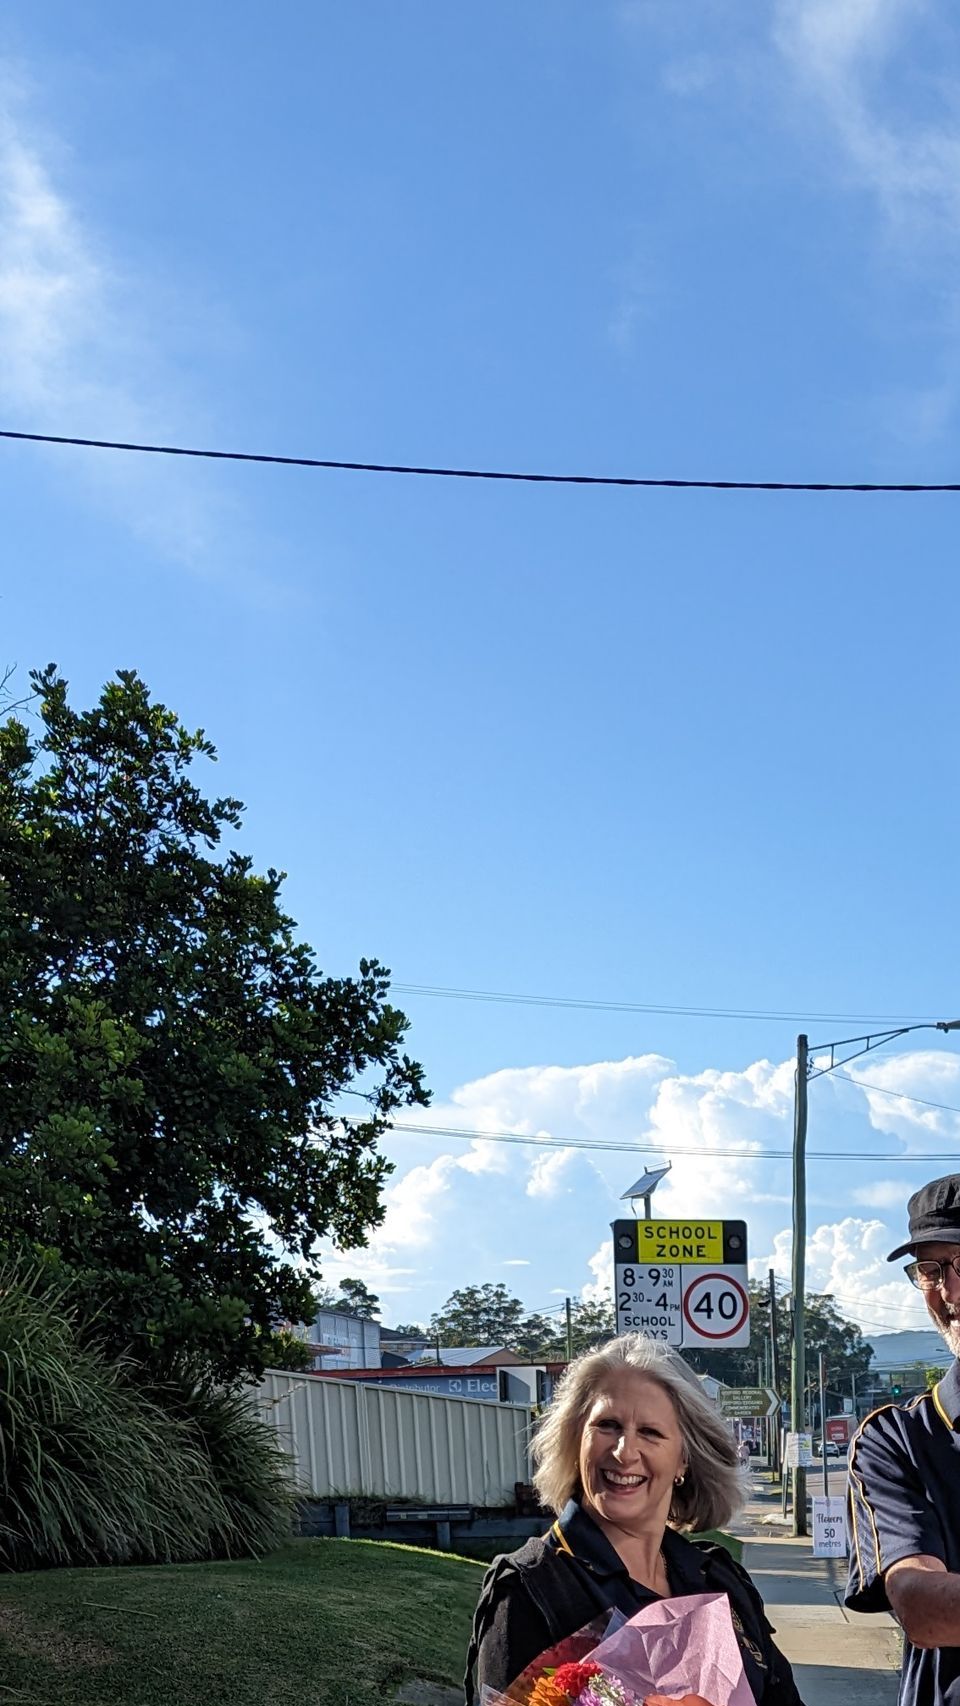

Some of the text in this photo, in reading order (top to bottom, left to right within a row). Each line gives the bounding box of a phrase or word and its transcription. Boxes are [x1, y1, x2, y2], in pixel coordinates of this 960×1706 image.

[644, 1226, 718, 1240] SCHOOL
[656, 1244, 707, 1258] ZONE
[693, 1291, 738, 1321] 40
[624, 1316, 676, 1326] SCHOOL
[824, 1528, 836, 1539] 50
[818, 1541, 842, 1549] metres
